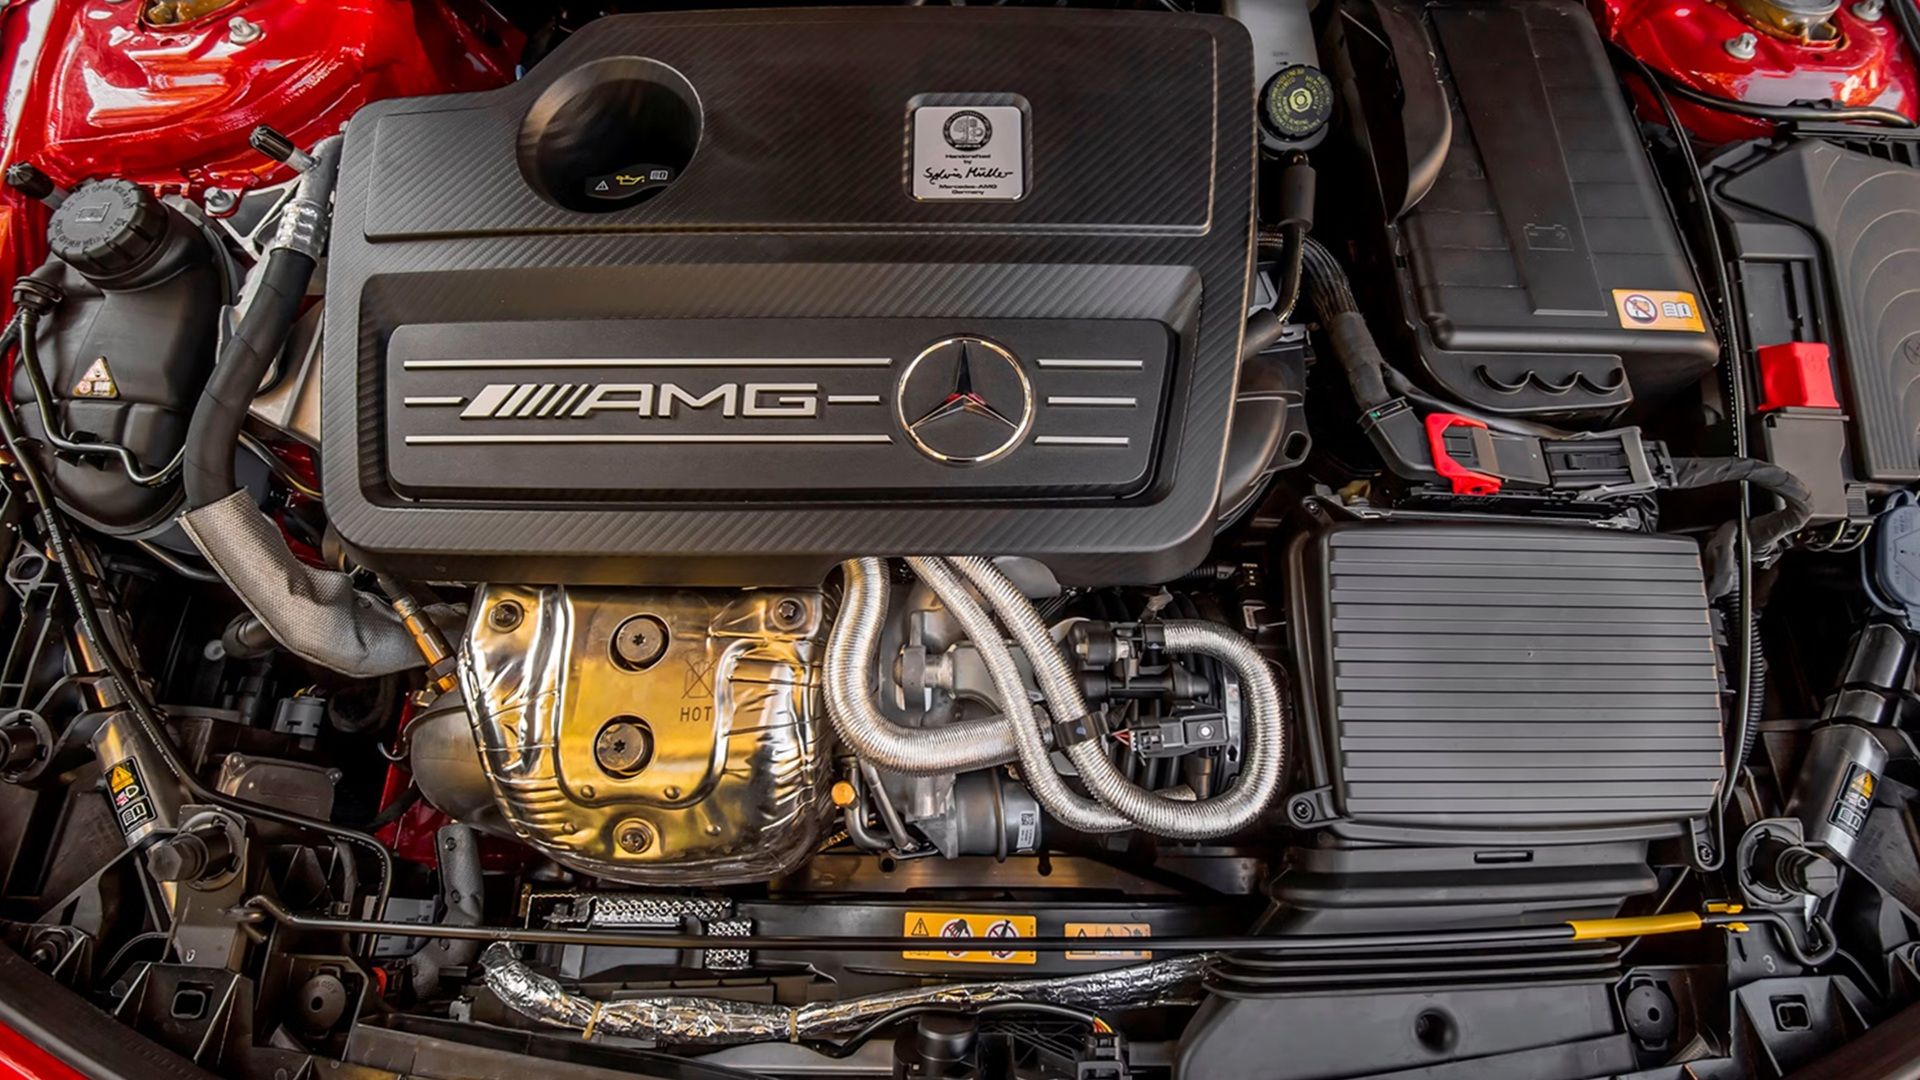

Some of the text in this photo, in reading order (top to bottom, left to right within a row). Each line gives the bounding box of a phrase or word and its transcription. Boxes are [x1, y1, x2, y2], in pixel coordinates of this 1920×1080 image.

[570, 382, 819, 418] AMG
[680, 706, 712, 721] HOT
[1762, 954, 1776, 973] 3
